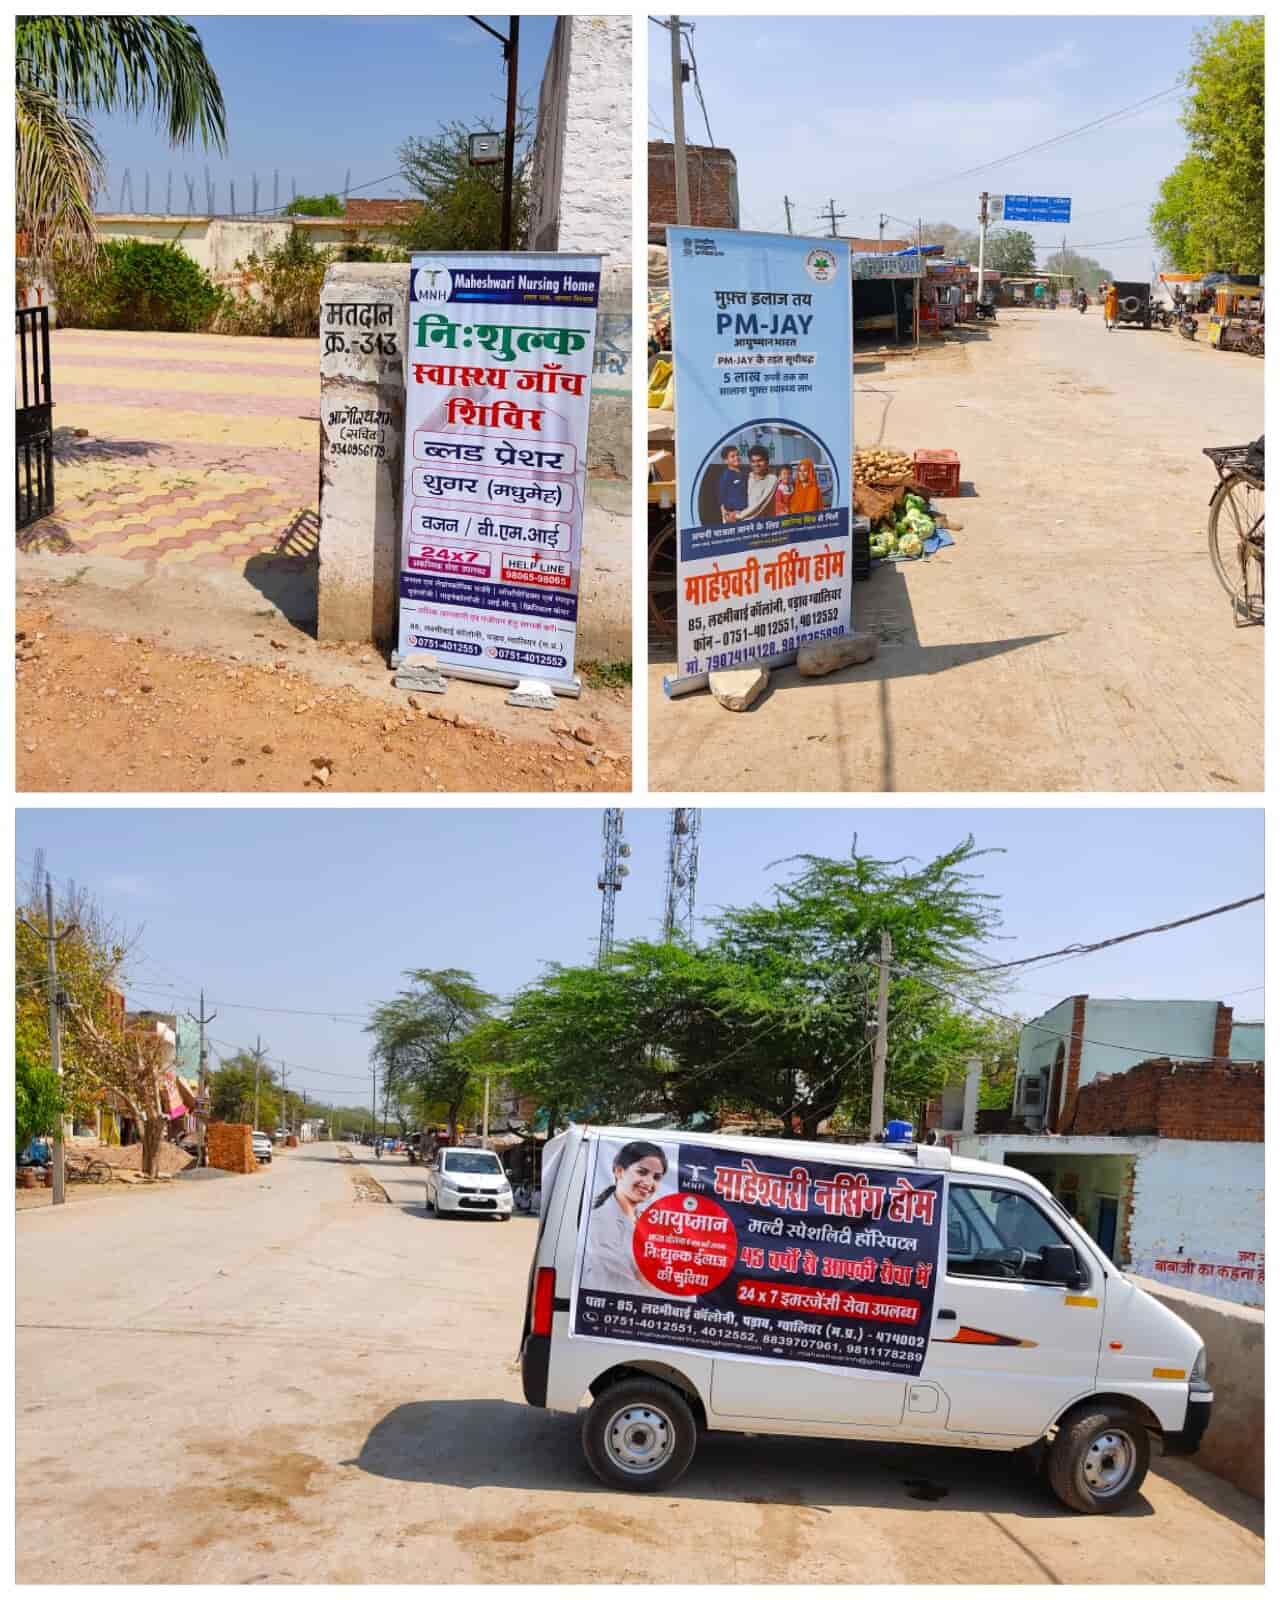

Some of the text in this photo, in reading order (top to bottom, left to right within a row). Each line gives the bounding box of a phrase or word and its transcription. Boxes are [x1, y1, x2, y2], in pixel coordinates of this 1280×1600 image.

[454, 273, 595, 293] Maheshwari Nursing Home
[419, 290, 446, 300] MNH
[750, 291, 788, 306] इलाज
[792, 294, 812, 306] तय
[325, 302, 393, 329] मतदान
[717, 313, 813, 335] PM-JAY
[775, 338, 797, 347] भारत
[718, 356, 753, 365] PM-JAY
[755, 354, 765, 365] के
[411, 362, 587, 397] स्वास्थ्य जाँच
[723, 372, 730, 383] 5
[734, 372, 761, 382] लाख
[444, 397, 545, 431] शिविर
[423, 440, 564, 469] ब्लड प्रेशर
[423, 474, 562, 506] शुगर (मधुमेह)
[421, 515, 459, 533] वजन
[421, 546, 481, 563] 24x7
[508, 559, 566, 574] HELP LINE
[684, 543, 846, 605] माहेश्वरी नर्सिंग होम
[688, 616, 706, 633] 85,
[801, 608, 838, 627] 4012552
[417, 637, 479, 655] 0751-4012551
[499, 650, 564, 667] 0751-4012552
[682, 1181, 705, 1191] MNH
[713, 1159, 937, 1226] माहेश्वरी नर्सिंग होम
[648, 1209, 728, 1234] आयुष्मान
[747, 1217, 918, 1252] मल्टी स्पेशलिटी हॉस्पिटल
[656, 1265, 709, 1288] की सुविधा
[739, 1246, 933, 1289] 45 वर्षों से आपकी सेवा में
[1198, 1264, 1215, 1276] का
[1217, 1265, 1256, 1281] कहना
[737, 1286, 755, 1301] 24
[770, 1289, 778, 1303] 7
[780, 1290, 840, 1312] इमरजेंसी
[843, 1296, 868, 1314] सेवा
[871, 1301, 917, 1321] उपलब्ध
[585, 1295, 605, 1309] पता
[617, 1300, 637, 1315] 85,
[875, 1331, 926, 1348] 474002
[603, 1314, 697, 1335] 0751-4012551,
[847, 1344, 923, 1362] 9811178289
